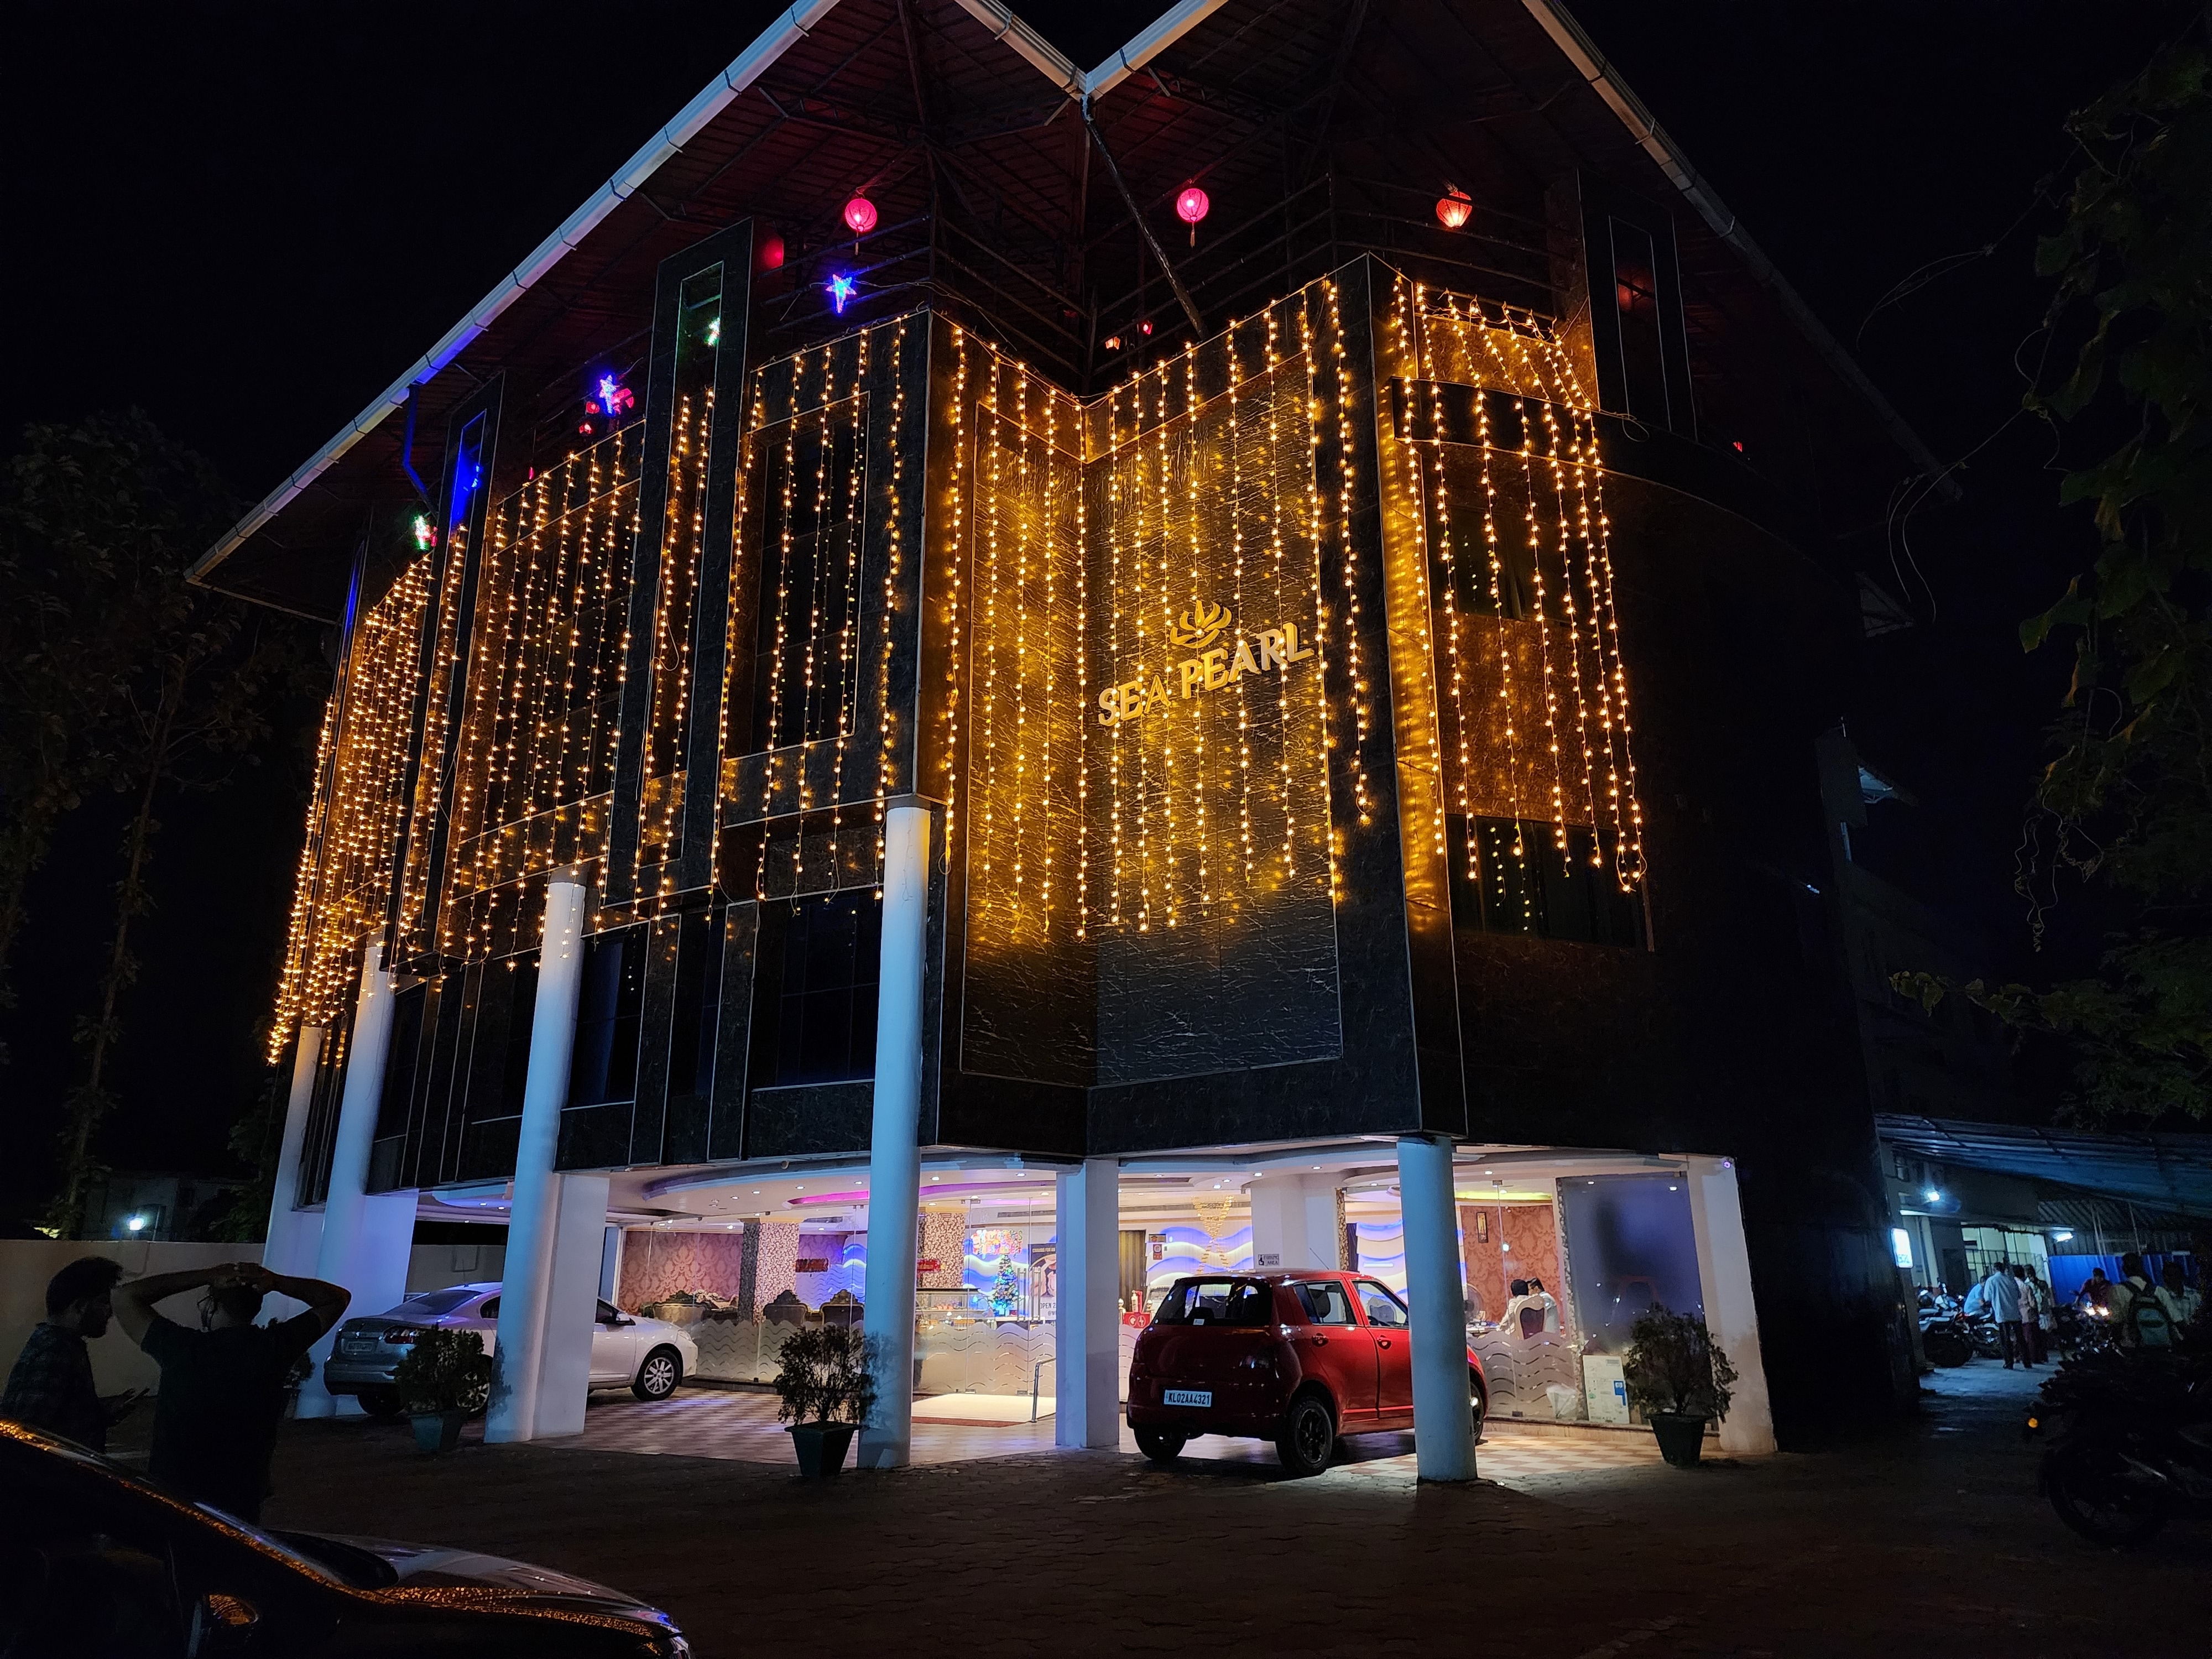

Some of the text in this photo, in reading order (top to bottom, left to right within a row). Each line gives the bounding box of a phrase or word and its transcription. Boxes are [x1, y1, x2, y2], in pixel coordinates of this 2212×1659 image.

[1098, 622, 1314, 726] SEA PEARL
[1168, 1392, 1209, 1405] KL02AA4321
